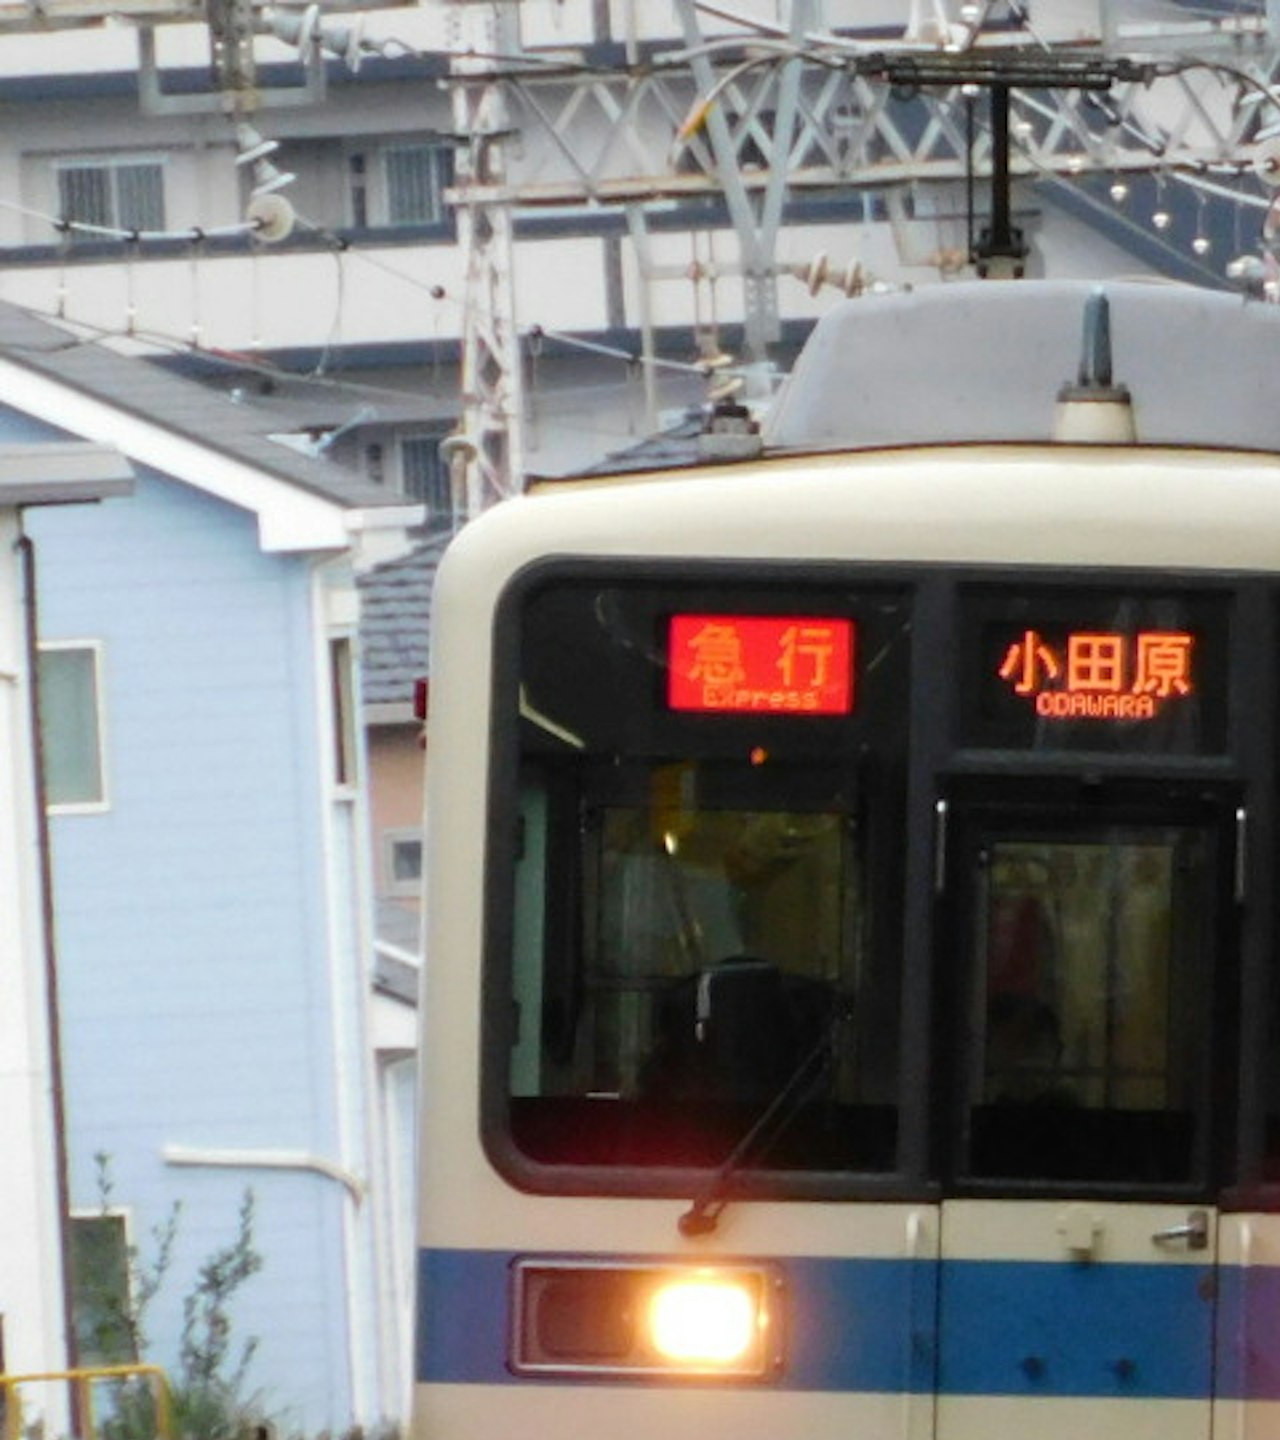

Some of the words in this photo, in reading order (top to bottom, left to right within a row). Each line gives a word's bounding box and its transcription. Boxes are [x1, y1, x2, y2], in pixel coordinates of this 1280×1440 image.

[687, 622, 835, 687] 急行
[999, 630, 1193, 697] 小田原
[703, 684, 820, 710] Express
[1035, 691, 1155, 718] ODAWARA
